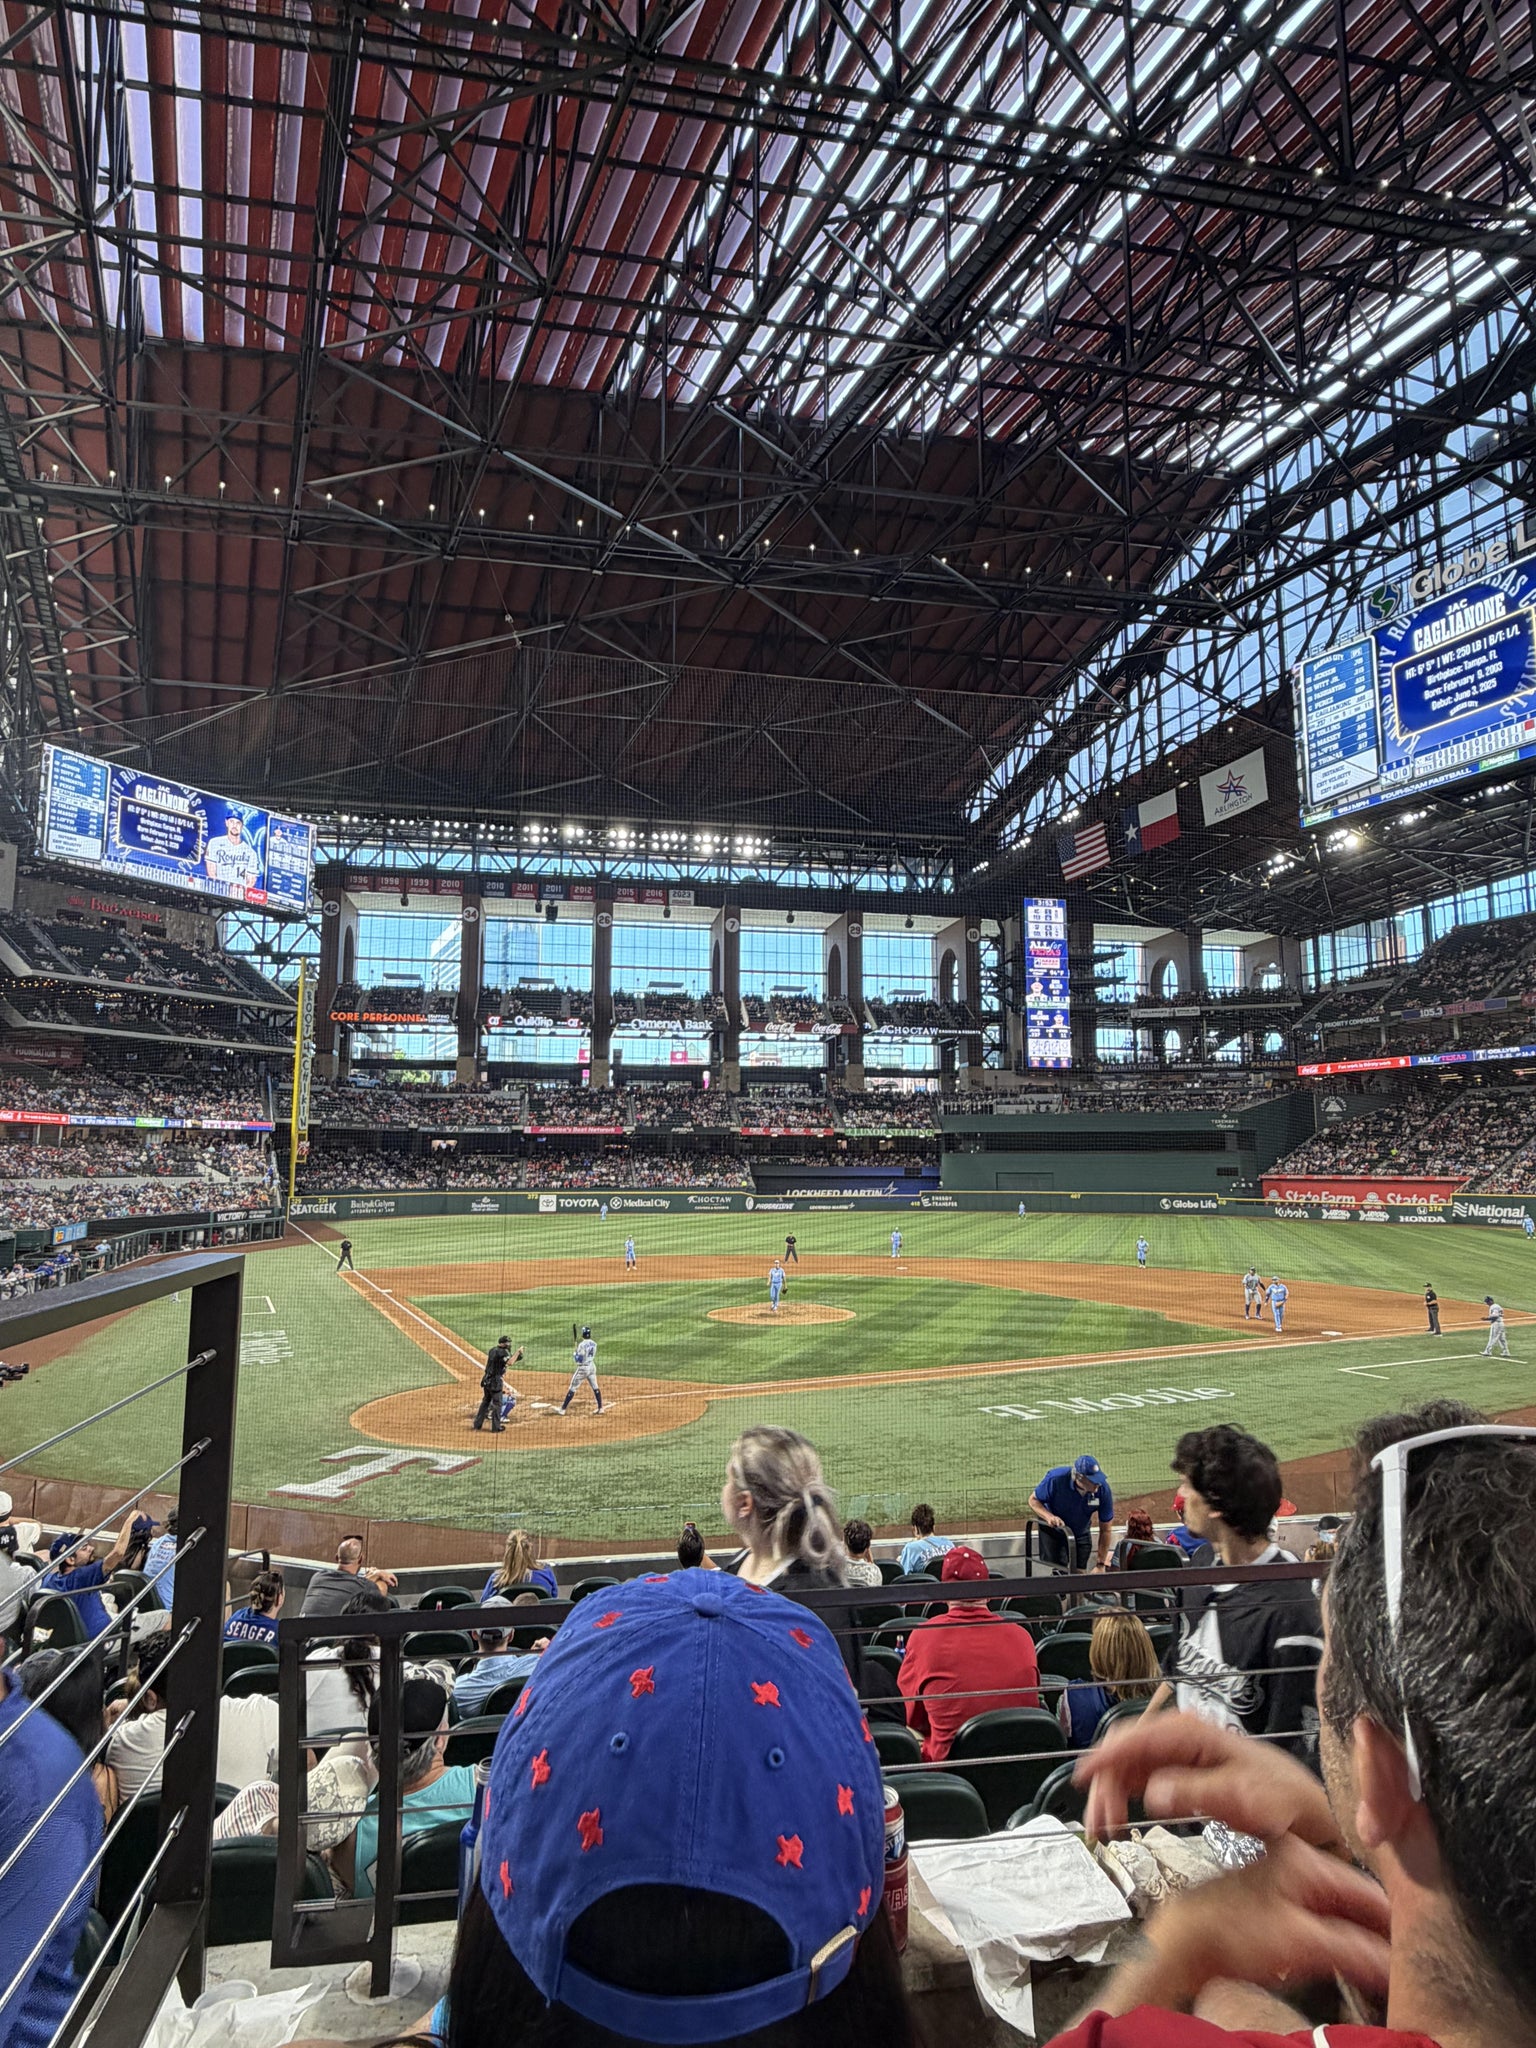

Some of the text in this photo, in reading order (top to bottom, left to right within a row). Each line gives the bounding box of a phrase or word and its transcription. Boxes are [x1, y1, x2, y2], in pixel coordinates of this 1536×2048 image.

[1409, 541, 1509, 599] Globe
[1445, 598, 1468, 615] JAC
[1413, 592, 1507, 652] CAGLIANONE
[1456, 645, 1471, 659] 250
[1472, 640, 1482, 653] LB
[1488, 649, 1498, 661] FL
[1443, 673, 1475, 693] February
[1487, 661, 1504, 676] 2003
[1453, 689, 1472, 702] June
[1479, 677, 1498, 694] 2025
[1427, 768, 1473, 786] FASTBALL
[135, 784, 190, 813] CAGLIANONE
[1214, 792, 1253, 815] ARLINGTON
[216, 850, 250, 868] Royals
[236, 867, 246, 879] 14
[410, 878, 430, 887] 1999
[441, 879, 460, 888] 2010
[486, 881, 504, 890] 2010
[516, 883, 533, 891] 2011
[574, 886, 592, 894] 2012
[617, 888, 635, 896] 2015
[646, 889, 663, 898] 2016
[672, 890, 691, 899] 2023
[90, 897, 162, 922] Budweiser
[325, 903, 338, 914] 42
[464, 910, 477, 919] 34
[598, 915, 611, 924] 26
[729, 921, 736, 930] 7
[849, 925, 861, 935] 29
[969, 931, 978, 939] 10
[330, 1012, 360, 1021] CORE
[362, 1012, 427, 1023] PERSONNEL
[1419, 1008, 1443, 1018] 105.3
[514, 1015, 553, 1027] QuikTrip
[684, 1019, 714, 1031] Bank
[887, 1025, 940, 1035] CHOCTAW
[1138, 1063, 1160, 1071] GOLD
[853, 1128, 933, 1137] LUXOR STAFFING
[558, 1198, 600, 1208] TOYOTA
[623, 1198, 671, 1209] Medical City
[691, 1196, 732, 1204] CHOCTAW
[1172, 1199, 1218, 1209] Globe Life
[290, 1202, 337, 1216] SEATGEEK
[1275, 1207, 1309, 1218] Kubota
[1468, 1203, 1525, 1218] National
[217, 1212, 244, 1222] VICTORY
[1399, 1215, 1446, 1223] HONDA
[1500, 1217, 1523, 1225] Rental
[1037, 1387, 1236, 1415] Mobile
[267, 1445, 483, 1503] T
[227, 1621, 275, 1643] SEAGER
